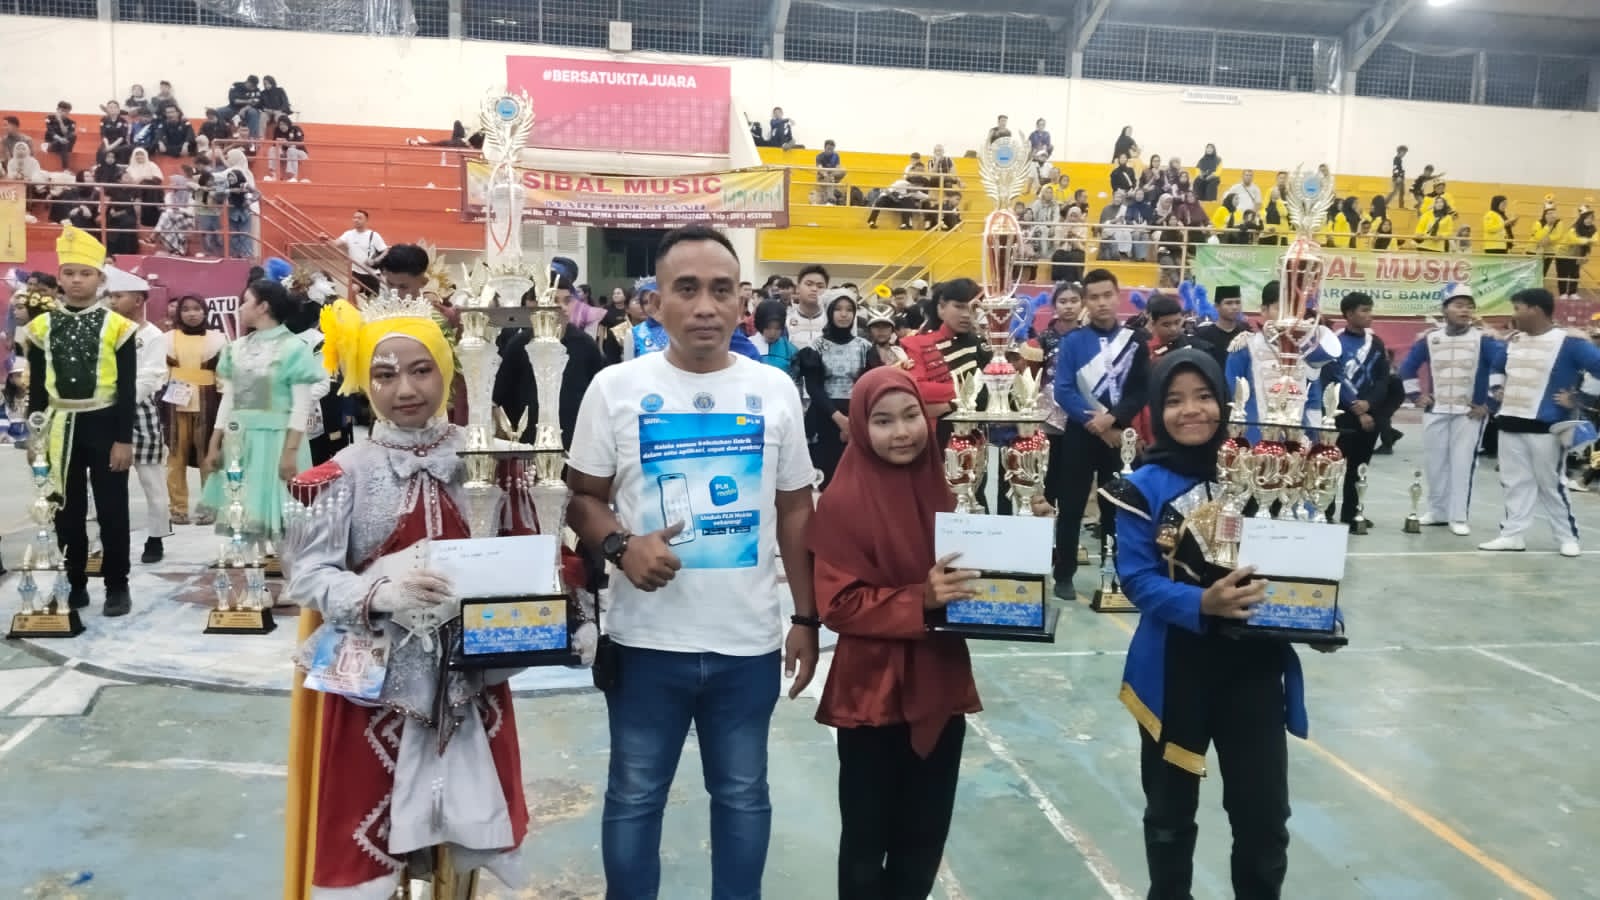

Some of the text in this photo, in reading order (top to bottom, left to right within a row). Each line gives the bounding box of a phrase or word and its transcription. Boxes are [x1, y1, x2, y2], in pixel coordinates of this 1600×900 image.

[543, 69, 697, 88] #BERSATUKITAJUARA
[522, 170, 721, 194] SIBAL MUSIC
[1376, 256, 1473, 283] MUSIC
[1399, 289, 1442, 301] BAND
[208, 298, 236, 312] ATU
[715, 483, 729, 491] PLN
